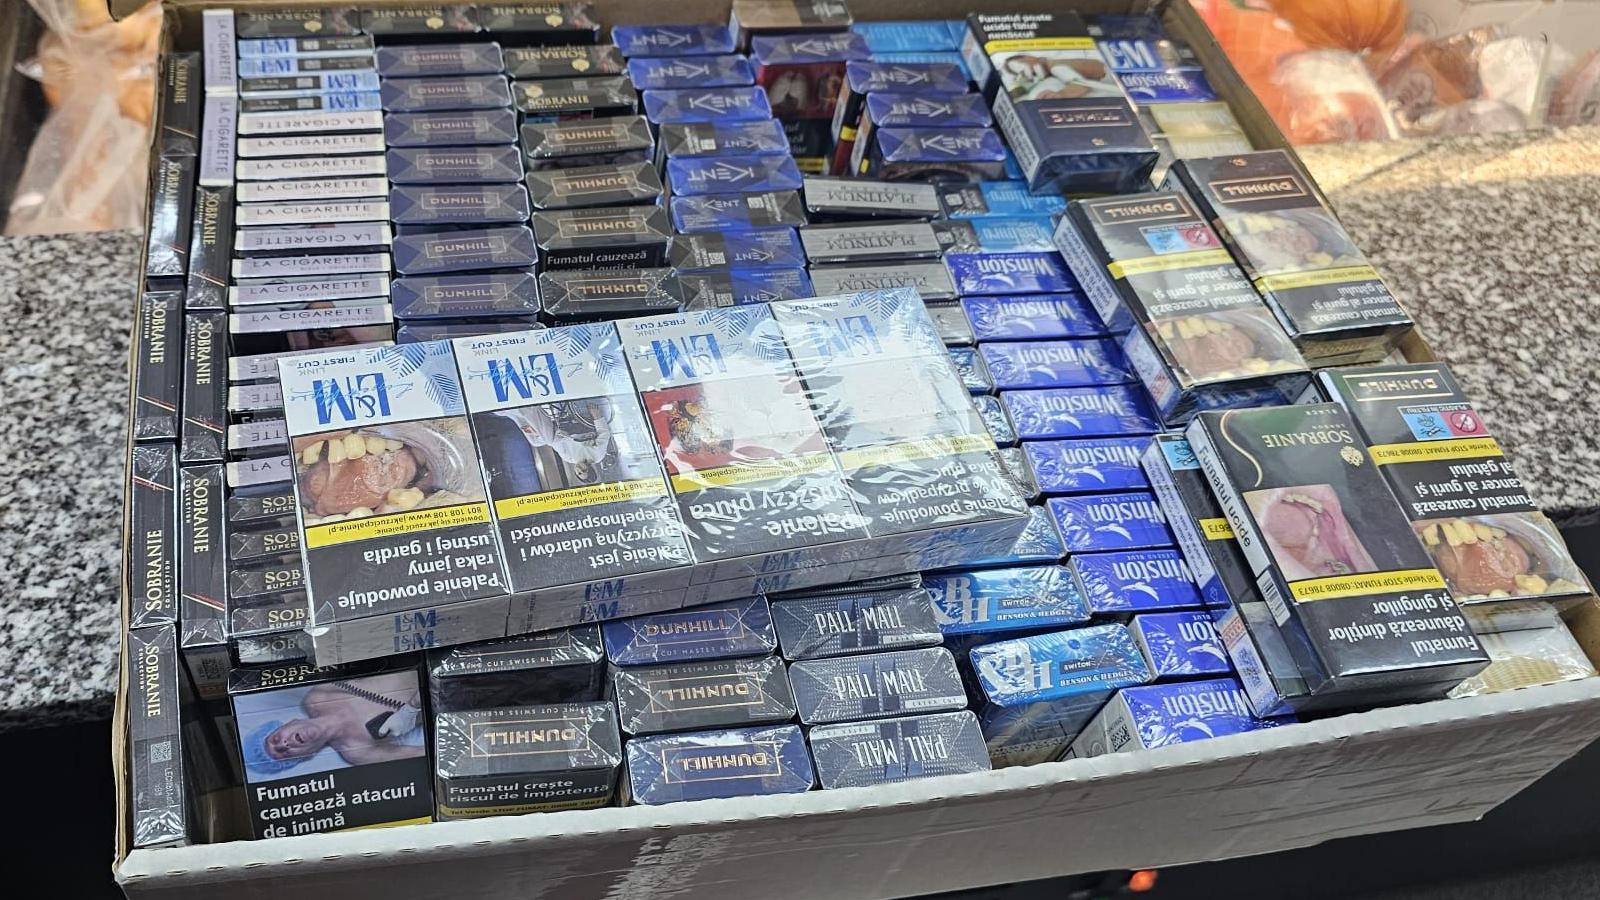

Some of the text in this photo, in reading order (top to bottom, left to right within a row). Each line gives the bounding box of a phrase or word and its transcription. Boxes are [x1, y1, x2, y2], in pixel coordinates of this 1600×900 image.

[632, 29, 692, 47] KENT
[648, 60, 710, 79] KENT
[689, 93, 752, 113] KENT
[889, 98, 951, 117] KENT
[256, 119, 339, 129] CIGARETTE
[421, 120, 480, 131] DUNHILL
[216, 118, 231, 173] CIGARETTE
[282, 136, 367, 146] CIGARETTE
[554, 129, 617, 142] DUNHILL
[921, 136, 982, 155] KENT
[282, 159, 367, 169] CIGARETTE
[425, 156, 484, 167] DUNHILL
[565, 175, 631, 189] DUNHILL
[688, 162, 754, 182] KENT
[282, 180, 369, 190] CIGARETTE
[1223, 180, 1293, 195] DUNHILL
[430, 196, 491, 206] DUNHILL
[827, 190, 915, 204] PLATINUM
[203, 192, 220, 245] SOBRANIE
[282, 205, 370, 215] CIGARETTE
[1105, 202, 1176, 217] DUNHILL
[571, 219, 638, 231] DUNHILL
[255, 234, 346, 245] CIGARETTE
[434, 241, 498, 254] DUNHILL
[827, 236, 916, 250] PLATINUM
[279, 256, 371, 266] CIGARETTE
[547, 250, 648, 265] Fumatul cauzează
[734, 248, 775, 262] KENT
[979, 257, 1056, 276] Winston
[277, 281, 370, 292] CIGARETTE
[433, 288, 497, 299] DUNHILL
[577, 283, 649, 295] DUNHILL
[252, 314, 270, 322] LA
[279, 307, 373, 320] CIGARETTE
[999, 301, 1077, 321] Winston
[149, 302, 166, 364] SOBRANIE
[634, 318, 687, 331] FIRST CUT
[196, 321, 212, 385] SOBRANIE
[472, 337, 527, 350] FIRST CUT
[323, 355, 356, 365] FIRST
[651, 333, 727, 381] L&M
[1017, 347, 1099, 368] Winston
[487, 352, 565, 403] L&M
[1358, 377, 1439, 392] DUNHILL
[313, 372, 391, 425] L&M
[1040, 394, 1125, 416] Winston
[1261, 429, 1355, 448] SOBRANIE
[252, 461, 271, 471] LA
[1063, 445, 1142, 467] Winston
[1447, 460, 1512, 478] al gâtului
[1199, 445, 1251, 549] Fumatul ucide
[1414, 477, 1524, 498] cancer al gurii și
[884, 495, 1021, 524] Palenie powoduje
[1411, 494, 1536, 515] Fumatul cauzează
[193, 478, 209, 553] SOBRANIE
[328, 506, 482, 535] 801 108 108 www.jakrzucicpalenie.pl
[374, 523, 404, 534] palenie:
[592, 525, 679, 547] przyczyną
[363, 541, 422, 563] gardła
[436, 534, 490, 551] ustnej
[530, 537, 593, 558] udarów
[407, 554, 494, 576] raka jamy
[590, 543, 681, 570] Palenie jest
[146, 529, 162, 611] SOBRANIE
[338, 572, 499, 609] Palenie powoduje
[585, 578, 625, 601] L&M
[1298, 574, 1439, 595] Tel Verde STOP FUMAT: 08008 78673
[579, 600, 619, 623] L&M
[1372, 593, 1455, 617] și gingiilor
[394, 609, 437, 634] L&M
[815, 605, 906, 635] PALL MALL
[997, 609, 1072, 622] BENSON HEDGES
[645, 616, 732, 637] DUNHILL
[1328, 614, 1465, 644] dăunează dinților
[392, 630, 435, 652] L&M
[1410, 634, 1479, 657] Fumatul
[487, 660, 504, 668] CUT
[145, 646, 160, 717] SOBRANIE
[834, 665, 928, 700] PALL MALL
[1060, 671, 1135, 687] BENSON HEDGES
[661, 682, 750, 702] DUNHILL
[1164, 687, 1248, 717] Winston
[484, 726, 577, 746] DUNHILL
[852, 734, 948, 768] PALL MALL
[681, 752, 768, 771] DUNHILL
[256, 774, 335, 801] Fumatul
[449, 784, 609, 803] riscul de impotență
[450, 780, 574, 795] Fumatul crește
[260, 783, 416, 821] cauzează atacuri
[263, 811, 345, 838] de inimă
